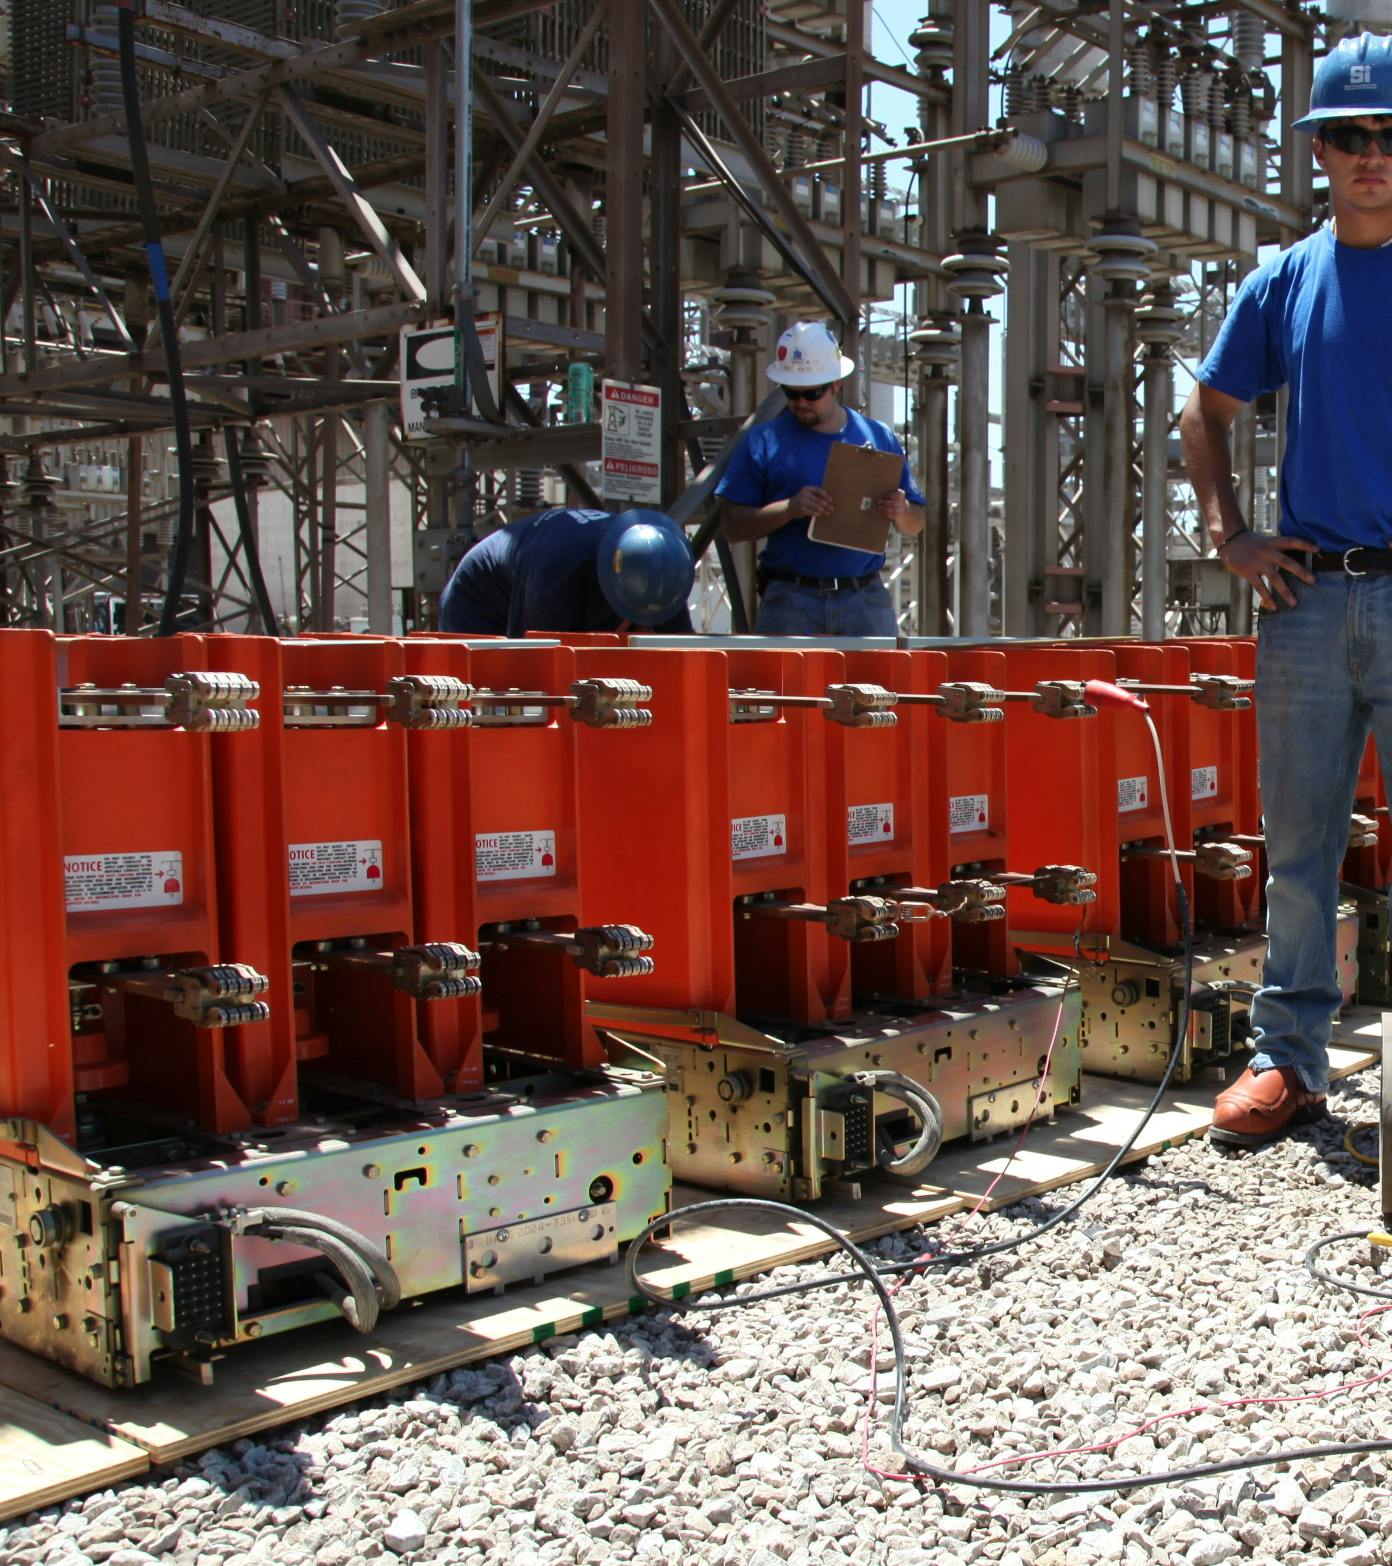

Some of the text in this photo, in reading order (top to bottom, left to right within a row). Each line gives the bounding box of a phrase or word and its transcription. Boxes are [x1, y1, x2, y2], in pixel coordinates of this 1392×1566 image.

[620, 391, 655, 405] DANGER
[615, 462, 658, 476] PELIGROSO
[64, 860, 103, 873] NOTICE
